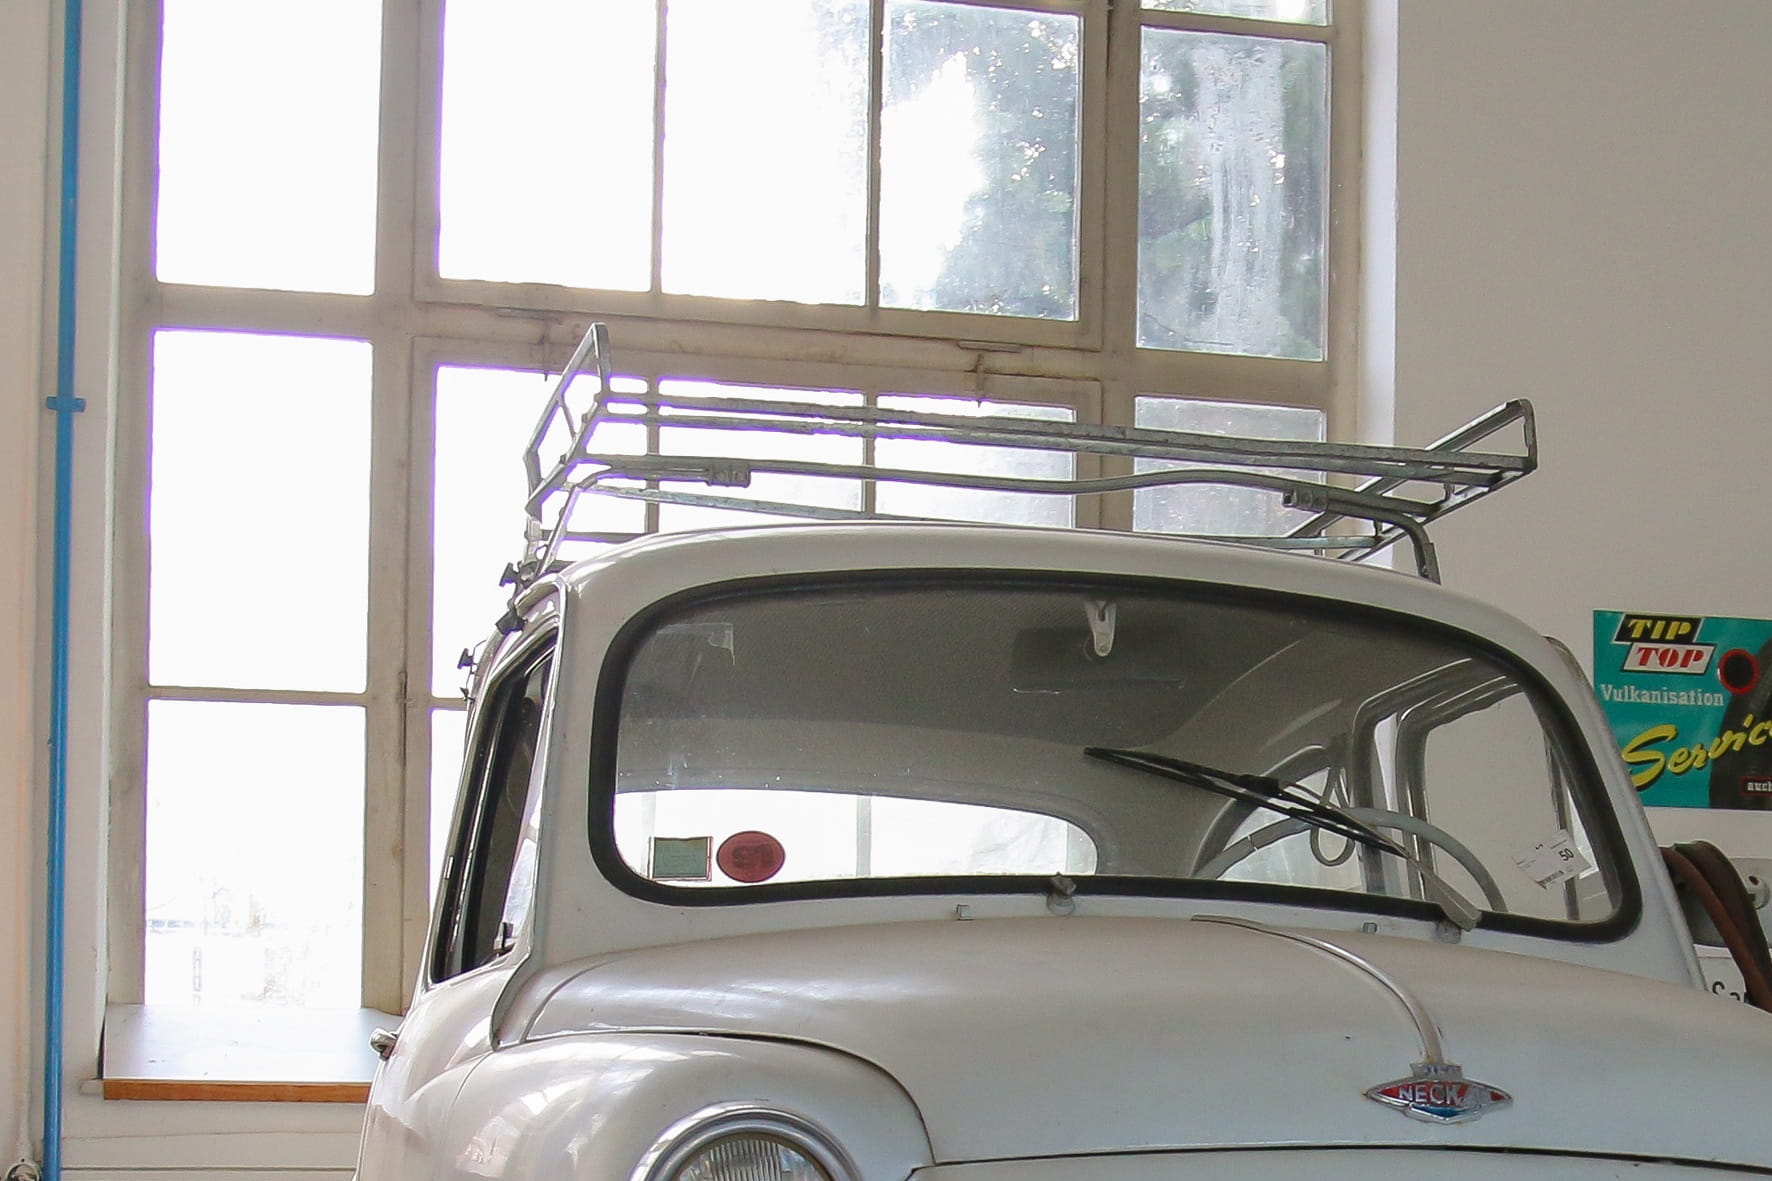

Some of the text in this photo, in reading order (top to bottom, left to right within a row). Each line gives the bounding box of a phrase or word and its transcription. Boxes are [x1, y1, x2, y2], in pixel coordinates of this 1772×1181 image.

[1627, 618, 1692, 641] TIP
[1636, 646, 1705, 669] TOP
[1600, 684, 1724, 707] Vulkanisation
[1558, 848, 1575, 862] 50
[1398, 1082, 1489, 1106] NECKA
